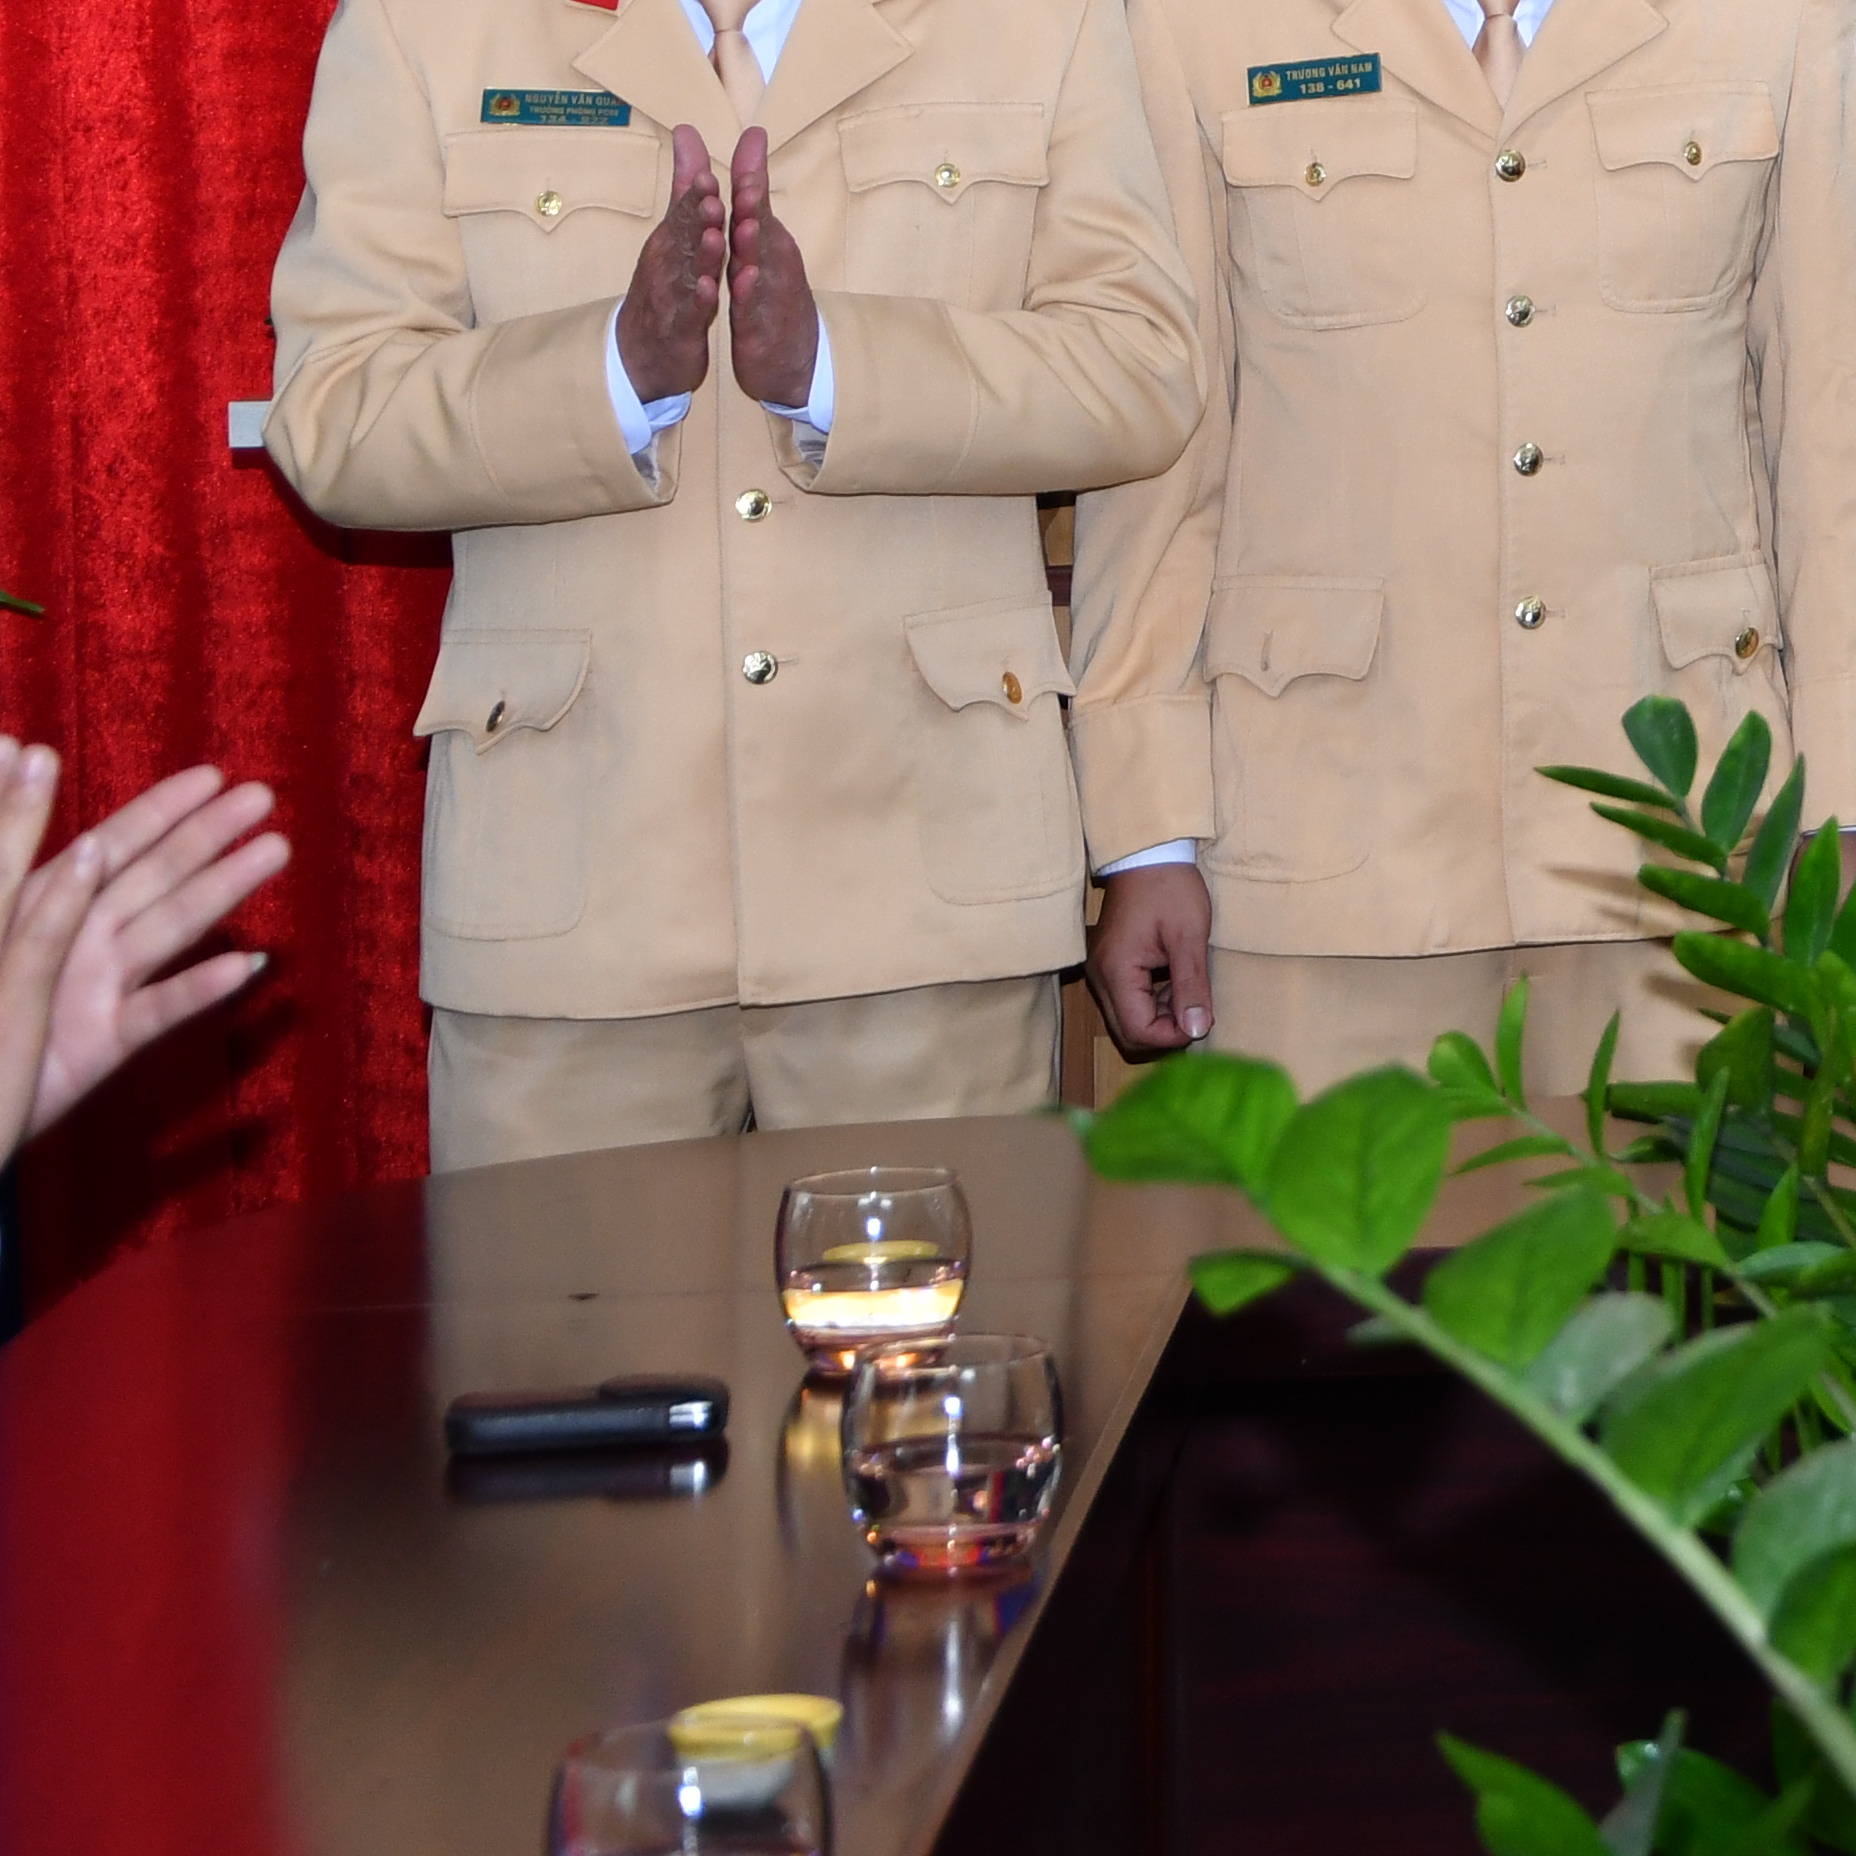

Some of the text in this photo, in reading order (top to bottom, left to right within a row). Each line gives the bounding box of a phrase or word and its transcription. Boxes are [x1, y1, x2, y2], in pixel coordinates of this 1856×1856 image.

[1328, 63, 1348, 76] VĂN
[1350, 62, 1373, 74] NAM
[1299, 82, 1325, 94] 138
[1336, 78, 1361, 91] 641
[571, 93, 593, 105] VĂN
